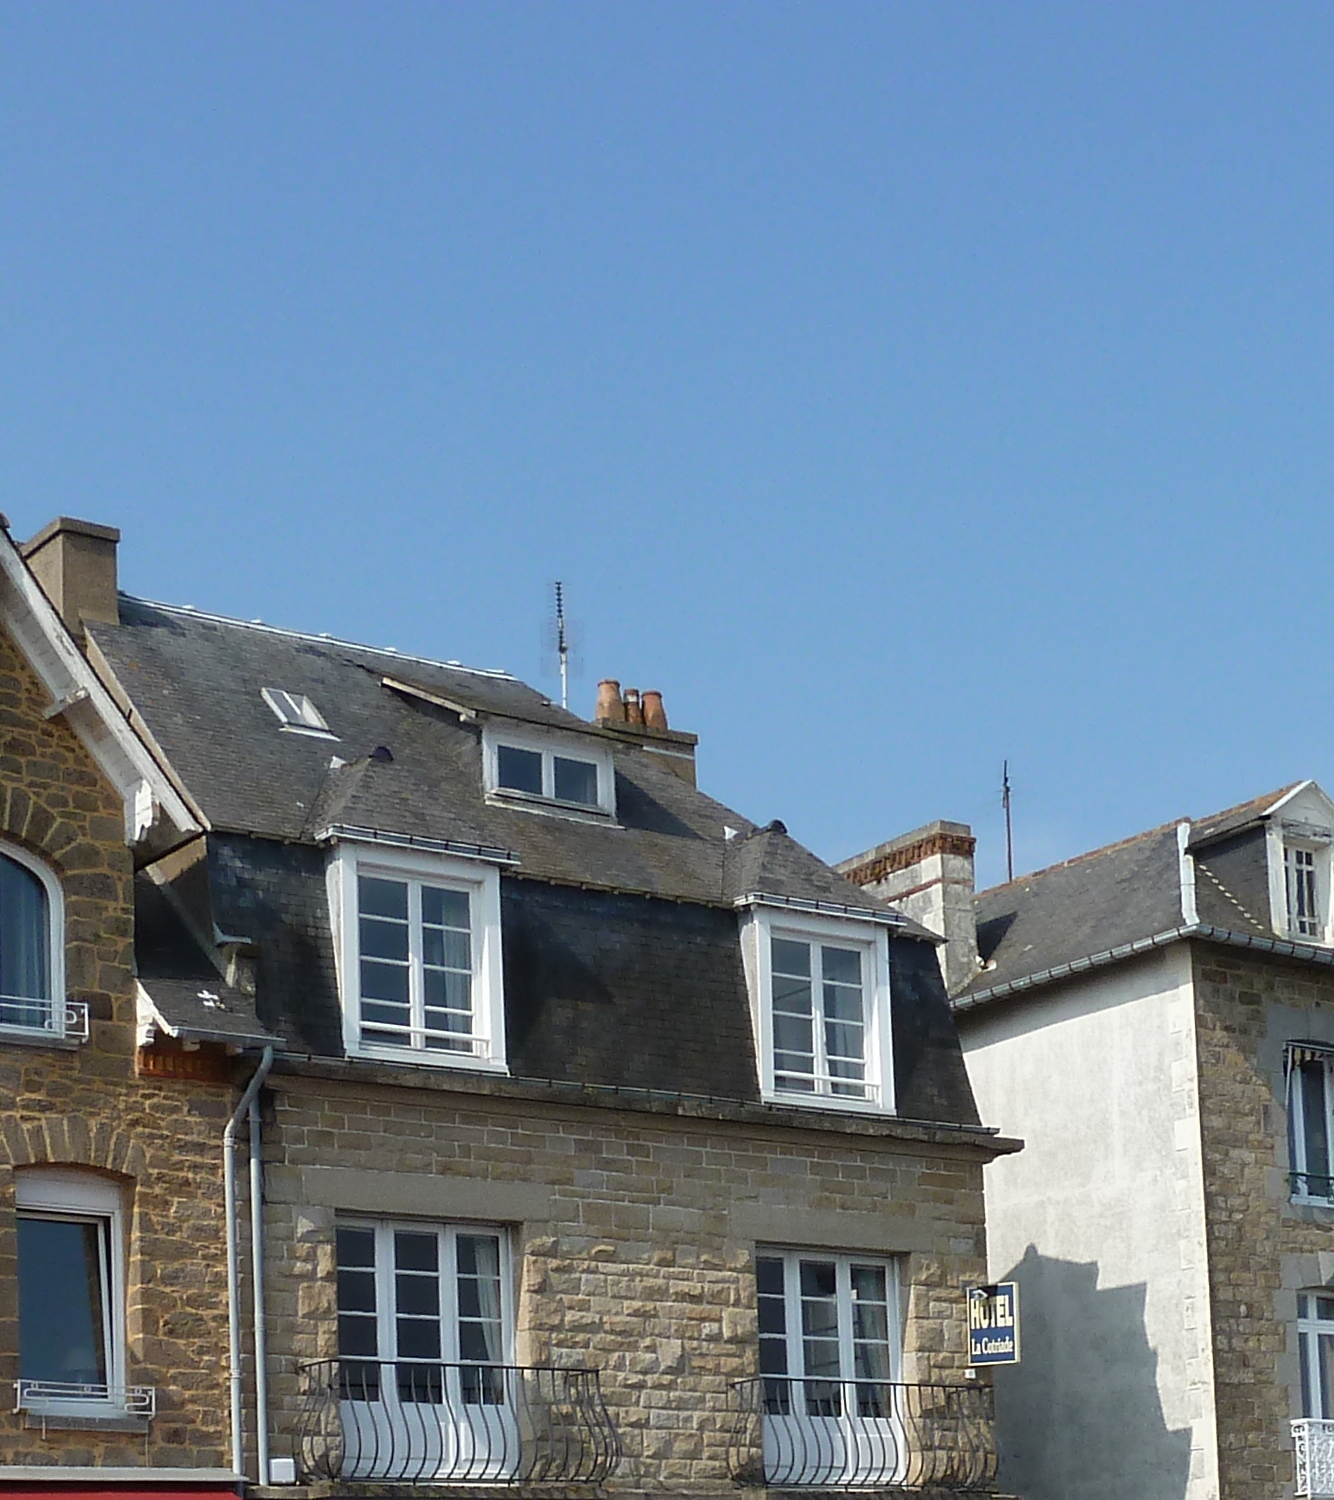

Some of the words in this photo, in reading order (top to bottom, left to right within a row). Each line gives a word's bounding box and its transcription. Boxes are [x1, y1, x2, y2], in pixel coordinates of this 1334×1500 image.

[971, 1295, 1013, 1329] HOTEL
[972, 1339, 981, 1355] La
[982, 1336, 1013, 1354] Cotriade
